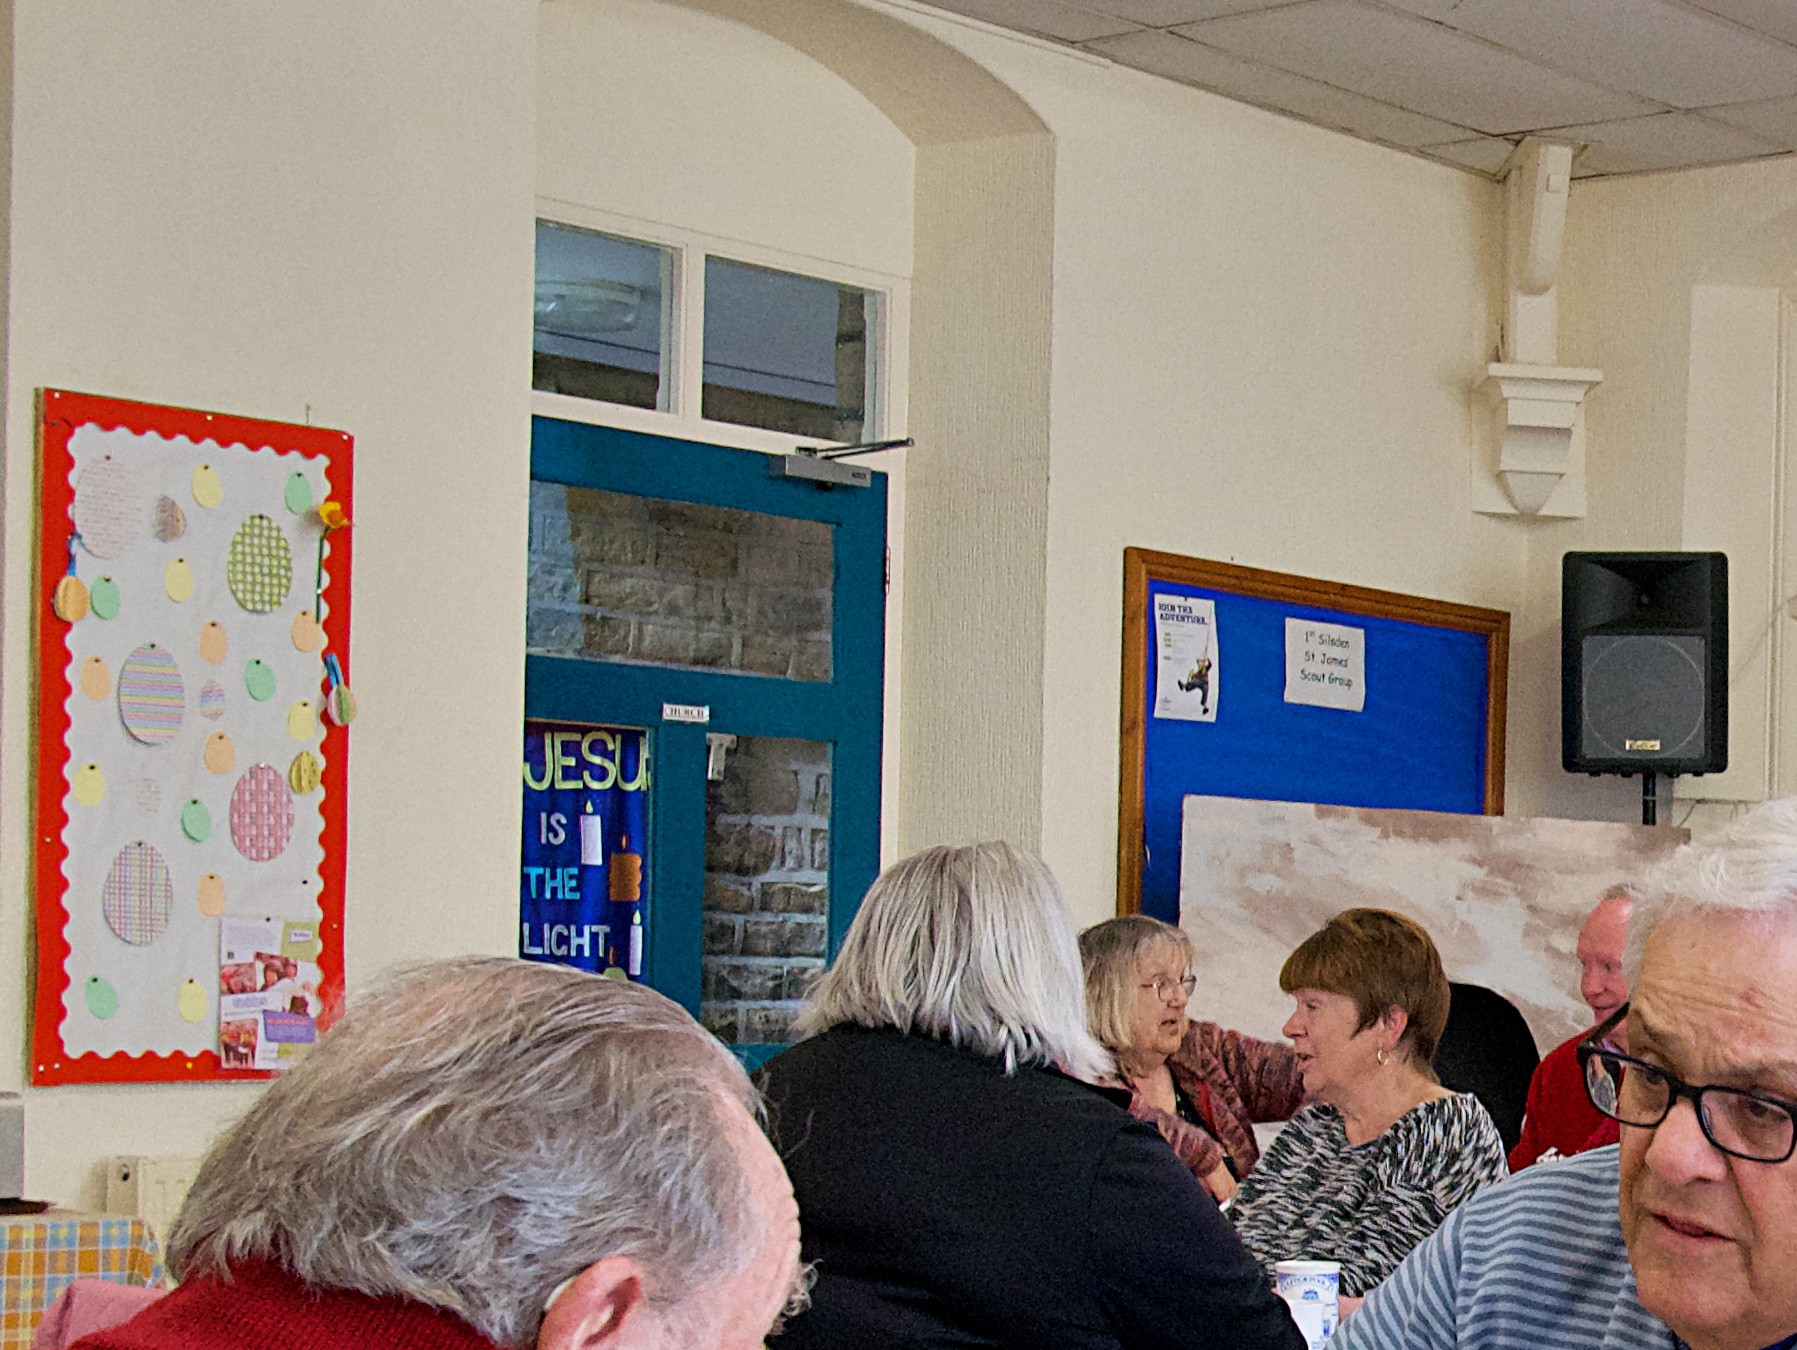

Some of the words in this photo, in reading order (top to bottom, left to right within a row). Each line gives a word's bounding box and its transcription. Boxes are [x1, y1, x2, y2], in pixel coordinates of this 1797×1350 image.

[1300, 668, 1325, 683] Scout
[1328, 672, 1353, 690] Group
[522, 731, 651, 792] JESU
[540, 812, 567, 845] IS
[523, 867, 580, 900] THE
[523, 922, 611, 958] LIGHT
